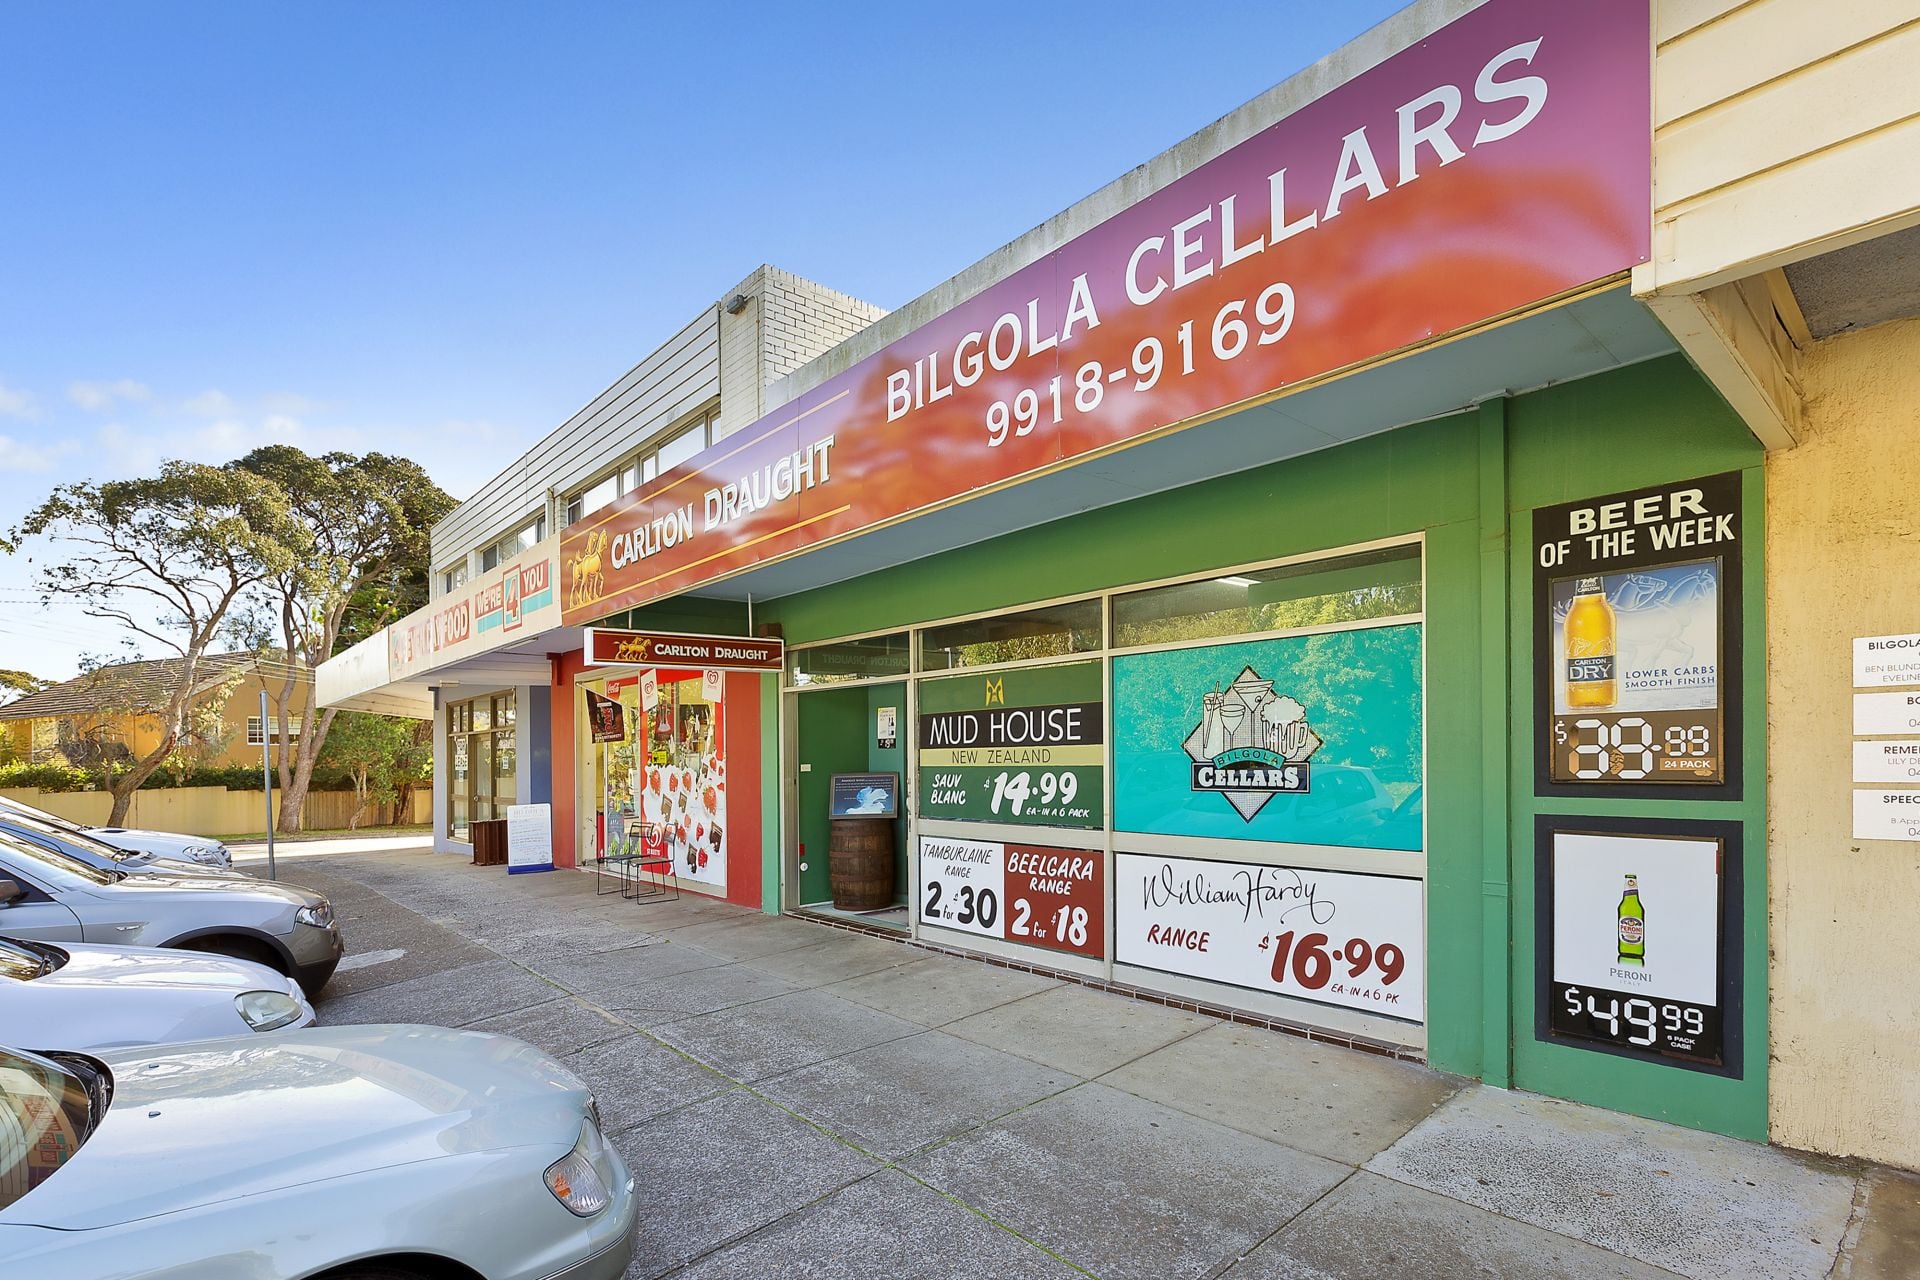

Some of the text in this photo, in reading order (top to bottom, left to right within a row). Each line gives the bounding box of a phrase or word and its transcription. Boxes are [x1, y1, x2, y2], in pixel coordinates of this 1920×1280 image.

[886, 36, 1549, 423] BILGOLA CELLARS
[985, 281, 1296, 448] 9918-9169
[611, 434, 836, 571] CARLTON DRAUGHT
[1569, 488, 1709, 536] BEER
[1540, 513, 1735, 568] OF THE WEEK
[476, 564, 544, 621] WE'RE 4 YOU
[654, 643, 769, 661] CARLTON DRAUGHT
[1569, 663, 1613, 680] DRY
[1625, 665, 1715, 679] LOWER CARBS
[1865, 665, 1885, 673] BEN
[1625, 676, 1715, 688] SMOOTH FINISH
[930, 714, 979, 745] MUD
[990, 708, 1082, 743] HOUSE
[952, 748, 1051, 764] NEW ZEALAND
[1217, 750, 1278, 766] BILGOLA
[1884, 746, 1920, 755] REME
[1664, 760, 1711, 768] 24 PACK
[932, 773, 962, 789] SAUV
[1198, 766, 1300, 789] CELLARS
[930, 789, 966, 805] BLANC
[1051, 808, 1058, 816] A
[1059, 808, 1066, 817] 6
[1068, 808, 1090, 818] PACK
[923, 843, 993, 865] TAMBURLAINE
[944, 865, 971, 879] RANGE
[1007, 851, 1094, 881] BEELGARA
[1029, 877, 1072, 896] RANGE
[1143, 864, 1336, 925] William Hardy
[924, 880, 942, 919] 2
[943, 904, 954, 920] for
[1011, 898, 1089, 947] 2 for $18
[1620, 924, 1643, 933] PERONI
[1147, 923, 1211, 953] RANGE
[1258, 930, 1405, 990] $16.99
[1609, 967, 1652, 983] PERONI
[1362, 988, 1371, 999] A
[1372, 987, 1381, 1001] 6
[1385, 993, 1400, 1004] PK
[1670, 1041, 1692, 1051] CASE
[1674, 1036, 1696, 1045] PACK
